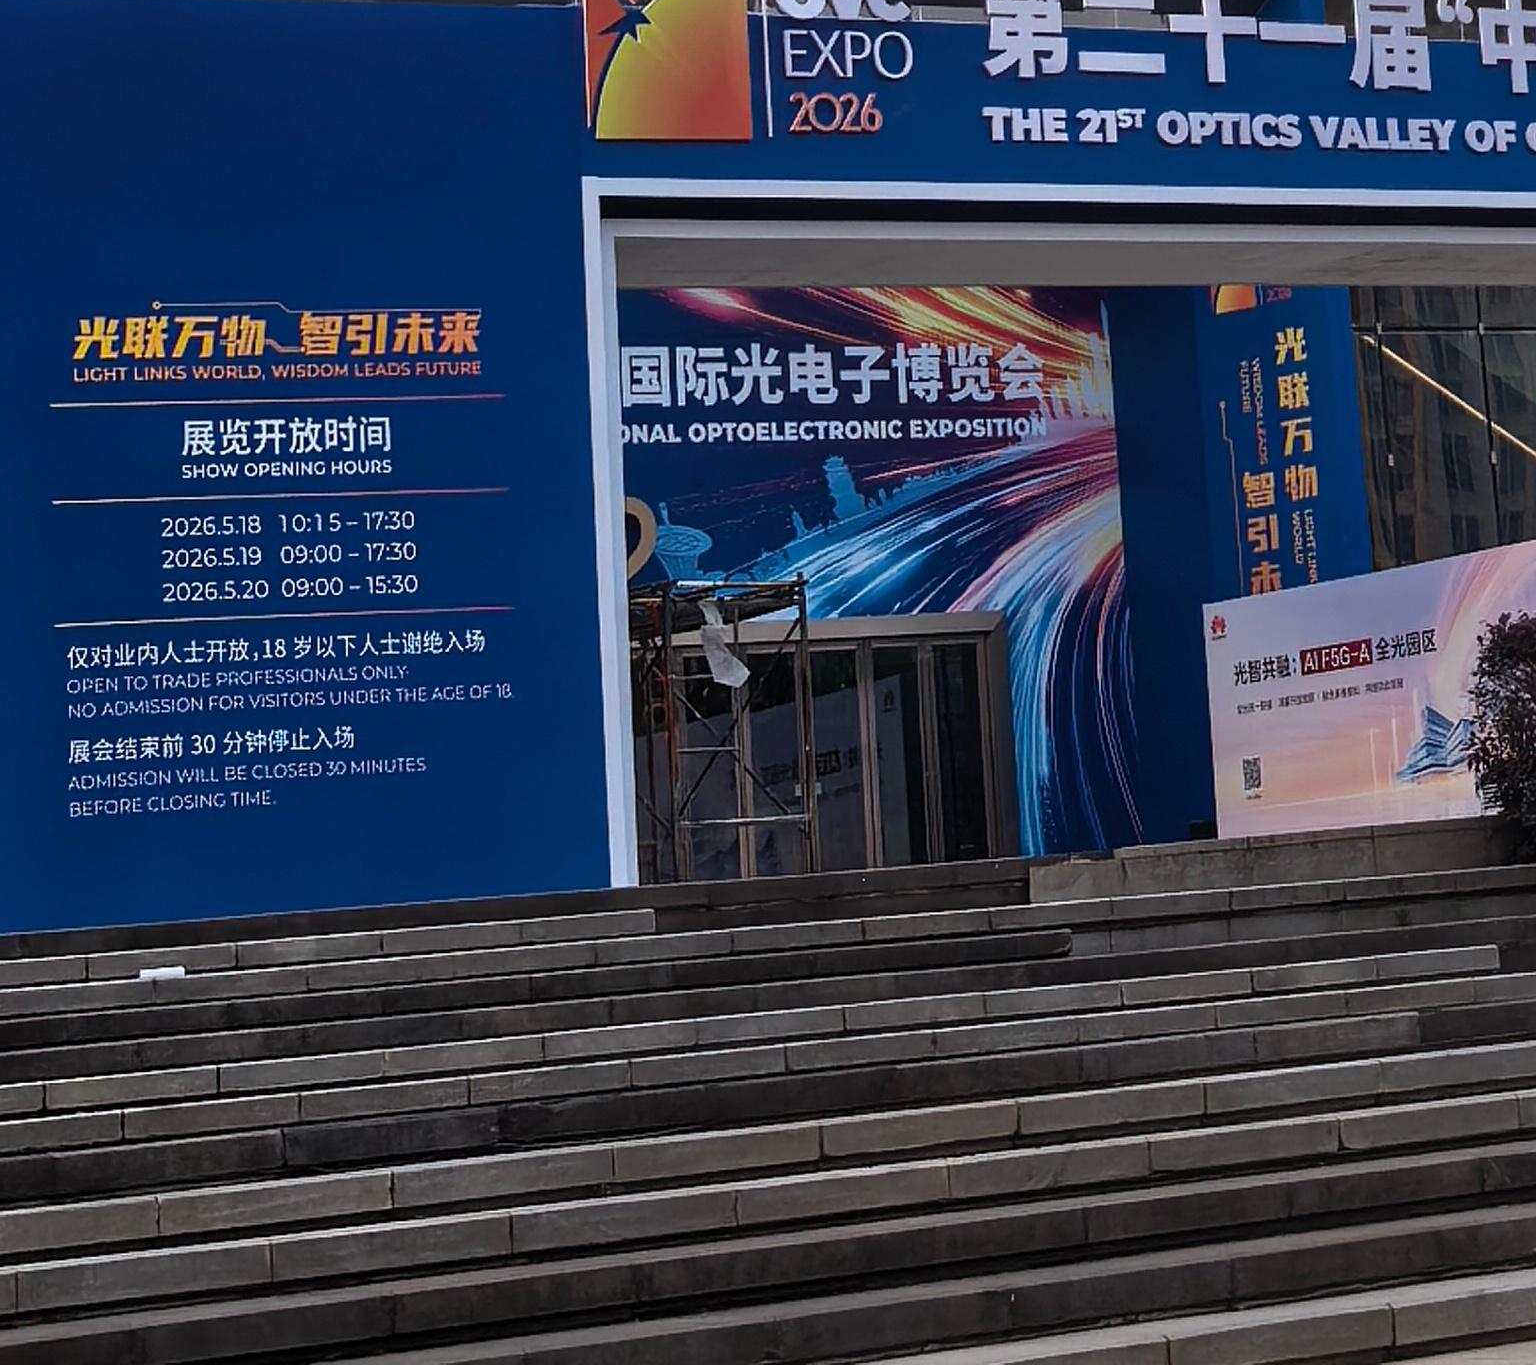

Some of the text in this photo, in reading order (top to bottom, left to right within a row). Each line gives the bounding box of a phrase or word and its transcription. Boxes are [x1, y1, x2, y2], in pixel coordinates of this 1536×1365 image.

[784, 30, 913, 78] EXPO
[788, 92, 883, 134] 2026
[982, 106, 1068, 144] THE
[1076, 106, 1147, 144] 21ST
[1156, 110, 1301, 148] OPTICS
[1308, 115, 1457, 153] VALLEY
[1465, 120, 1518, 153] OF
[72, 311, 482, 360] 光联万物 智引未来
[73, 360, 481, 383] LIGHT LINKS WORLD, WISDOM LEADS FUTURE
[621, 342, 1045, 407] 国际光电子博览会
[1274, 326, 1319, 501] 光联万物
[181, 415, 391, 456] 展览开放时间
[688, 420, 902, 443] OPTOELECTRONIC
[910, 415, 1047, 440] EXPOSITION
[181, 459, 393, 479] SHOW OPENING HOURS
[161, 514, 262, 537] 2026.5.18
[278, 512, 342, 533] 10:15
[363, 510, 415, 531] 17:30
[161, 546, 262, 569] 2026.5.19
[279, 544, 342, 564] 09:00
[364, 541, 417, 562] 17:30
[162, 579, 269, 603] 2026.5.20
[281, 576, 344, 598] 09:00
[365, 574, 419, 594] 15:30
[1321, 643, 1371, 668] F5G-A
[66, 677, 118, 694] OPEN
[123, 675, 148, 691] TO
[152, 672, 211, 690] TRADE
[215, 666, 358, 686] PROFESSIONALS
[68, 702, 97, 718] NO
[101, 697, 203, 716] ADMISSION
[208, 695, 244, 711] FOR
[248, 691, 326, 709] VISITORS
[329, 688, 392, 706] UNDER
[395, 686, 427, 702] THE
[431, 684, 465, 701] AGE
[469, 684, 492, 699] OF
[190, 734, 216, 756] 30
[68, 757, 427, 790] ADMISSION WILL BE CLOSED 30 MINUTES
[69, 797, 143, 818] BEFORE
[147, 792, 226, 812] CLOSING
